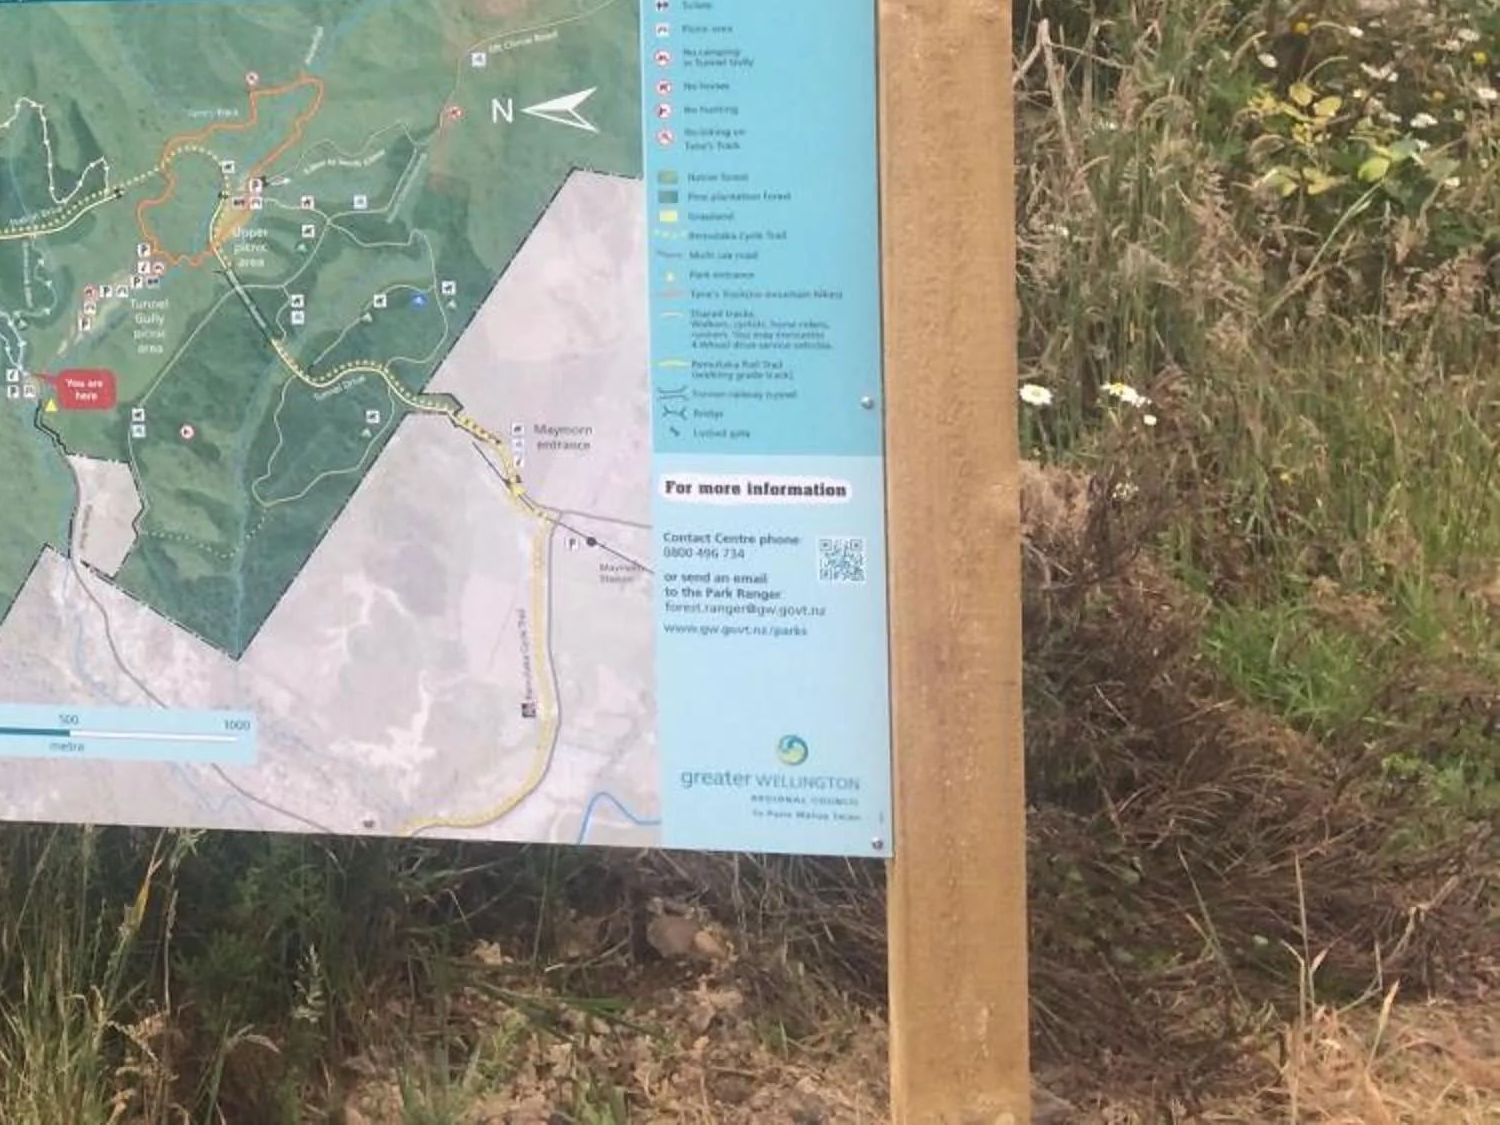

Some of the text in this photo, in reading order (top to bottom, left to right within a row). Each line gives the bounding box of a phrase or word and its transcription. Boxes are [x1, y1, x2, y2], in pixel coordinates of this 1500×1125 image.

[492, 99, 513, 124] N
[232, 228, 268, 239] Upper
[238, 257, 265, 269] area
[131, 298, 169, 310] Tunnel
[137, 343, 164, 355] area
[65, 378, 103, 388] You are
[75, 390, 98, 400] here
[536, 439, 591, 450] entrance
[665, 480, 847, 498] For more information
[663, 532, 800, 547] Contact Centre phone
[663, 547, 693, 559] 0800
[722, 548, 745, 560] 734
[663, 572, 768, 585] or send an email
[664, 587, 781, 602] to the Park Ranger
[59, 713, 79, 726] 500
[224, 719, 251, 732] 1000
[681, 770, 861, 791] greater WELLINGTON
